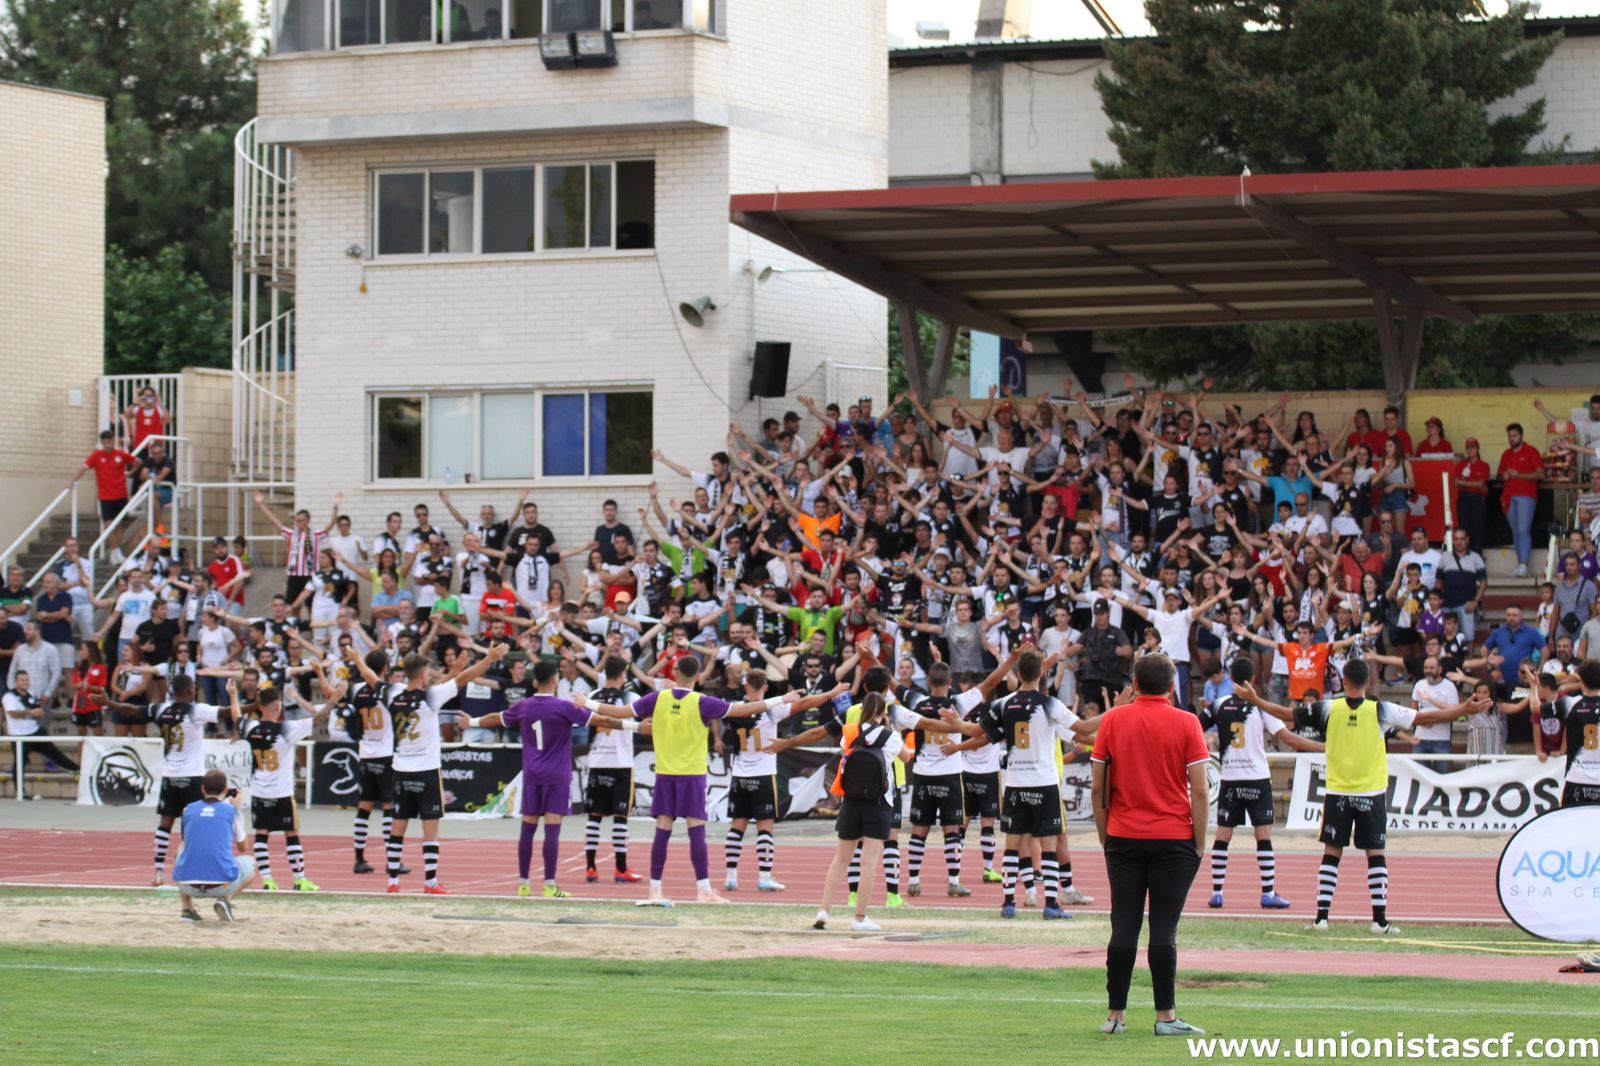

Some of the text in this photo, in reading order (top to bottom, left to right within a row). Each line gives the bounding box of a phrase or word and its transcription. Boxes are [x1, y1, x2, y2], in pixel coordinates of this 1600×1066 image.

[359, 707, 384, 730] 10
[395, 710, 420, 742] 22
[531, 720, 543, 750] 1
[736, 728, 761, 752] 11
[1014, 721, 1030, 750] 6
[1230, 722, 1245, 749] 3
[1583, 724, 1599, 750] 8
[253, 749, 279, 772] 18
[1510, 885, 1552, 897] SPA
